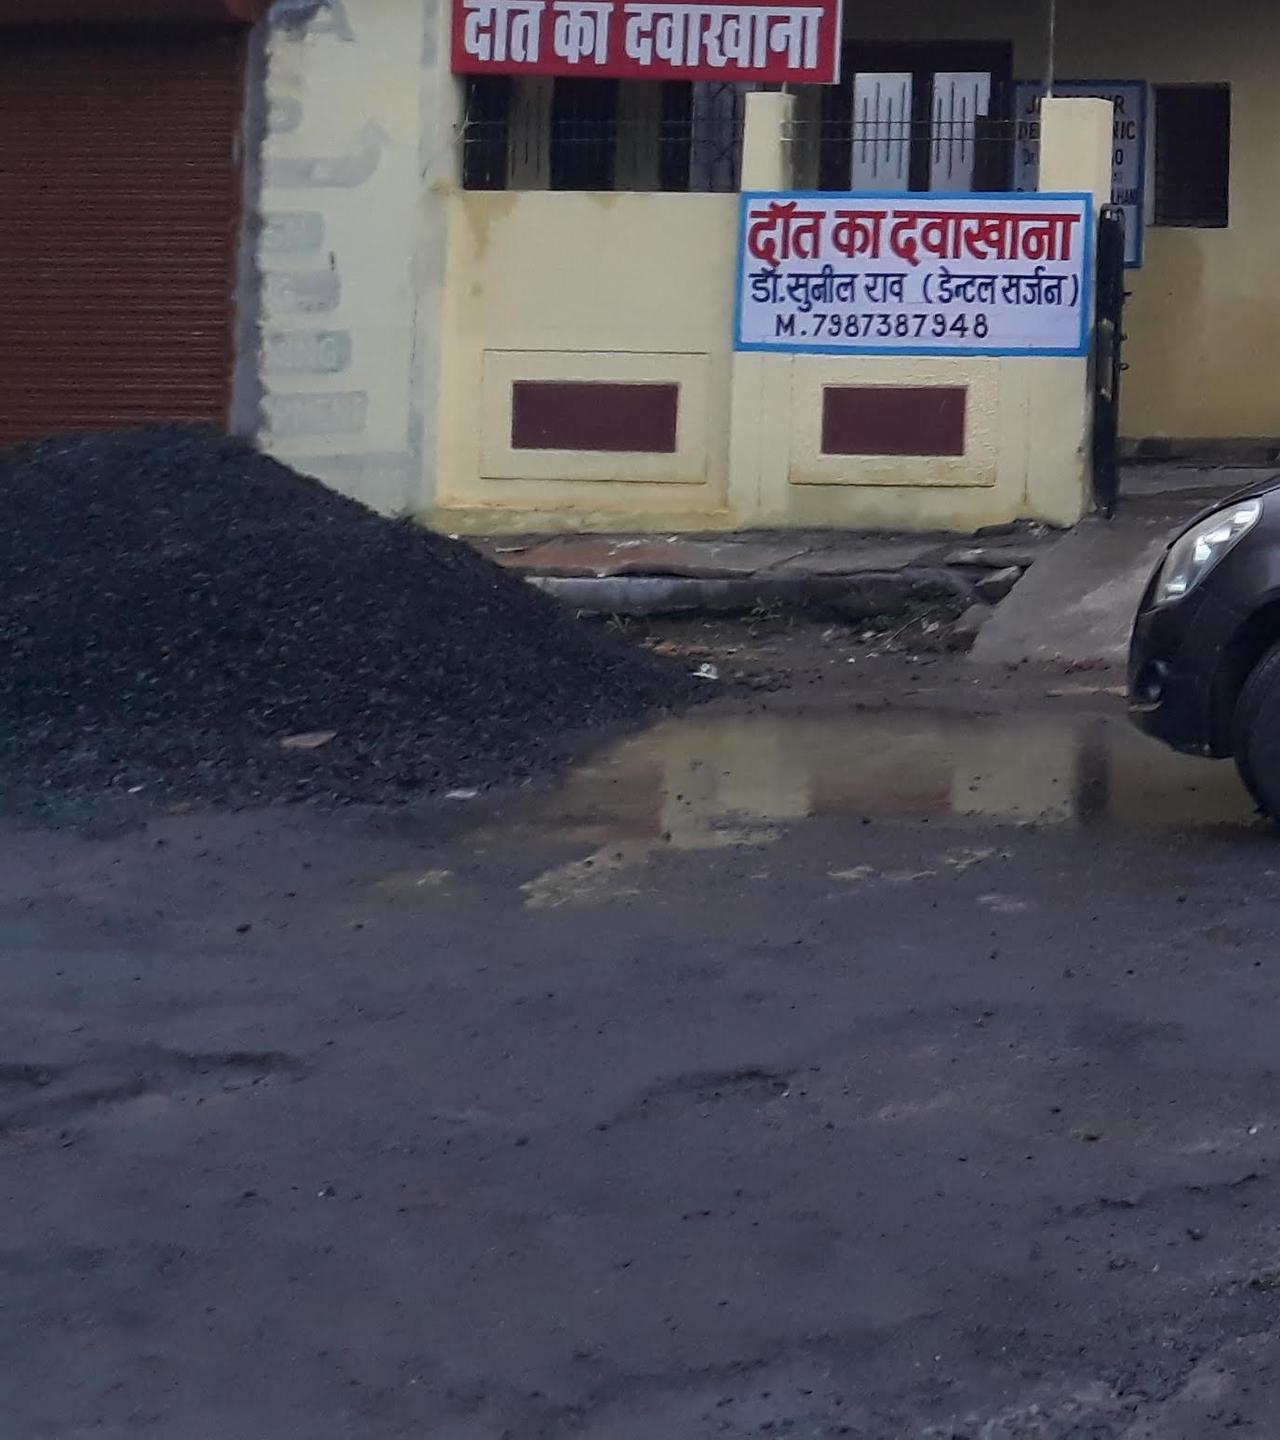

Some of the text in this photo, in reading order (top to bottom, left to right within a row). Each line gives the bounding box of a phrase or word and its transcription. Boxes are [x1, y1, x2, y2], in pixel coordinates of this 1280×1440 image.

[553, 1, 613, 64] का
[624, 3, 824, 69] दवाखाना
[832, 210, 886, 259] का
[890, 210, 1080, 266] दवाखाना
[864, 273, 907, 302] राव
